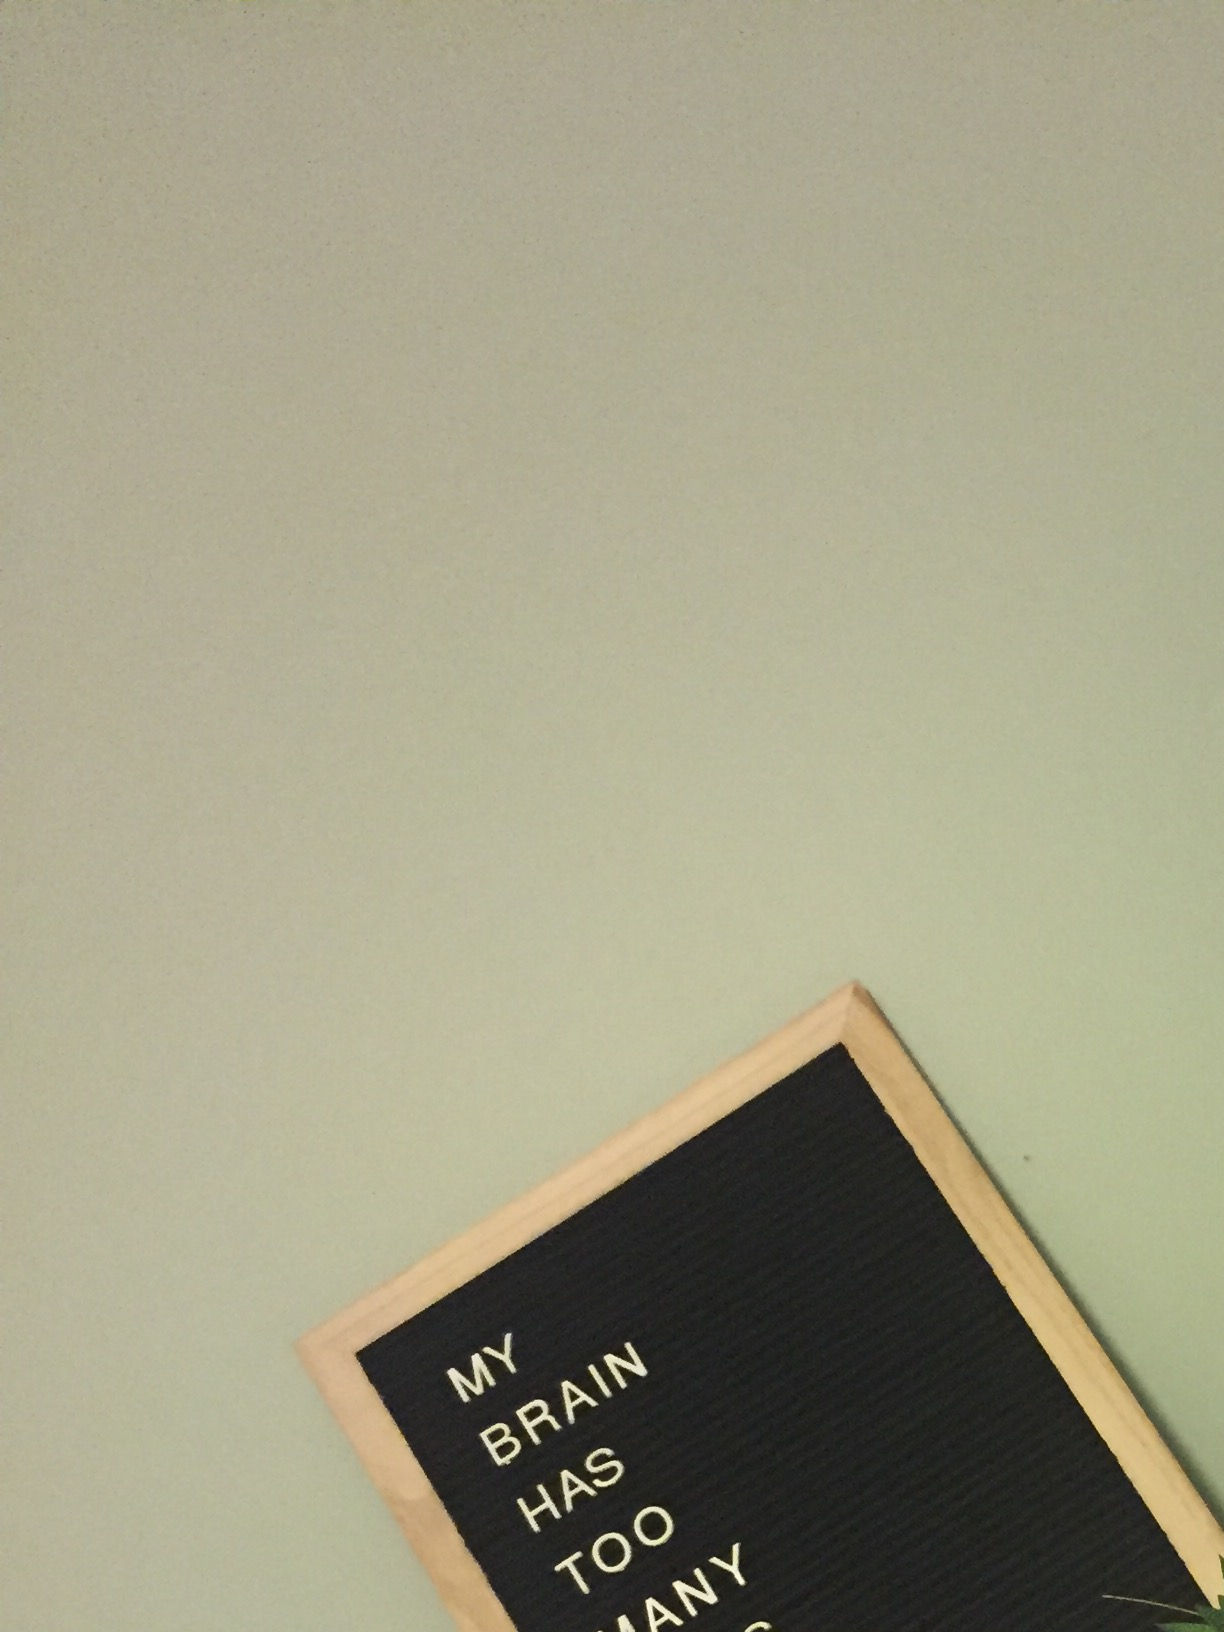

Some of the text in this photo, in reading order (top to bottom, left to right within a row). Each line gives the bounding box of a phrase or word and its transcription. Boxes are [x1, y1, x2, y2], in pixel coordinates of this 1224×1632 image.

[446, 1332, 518, 1403] MY
[478, 1341, 648, 1467] BRAIN
[516, 1447, 626, 1533] HAS
[554, 1505, 675, 1595] TOO
